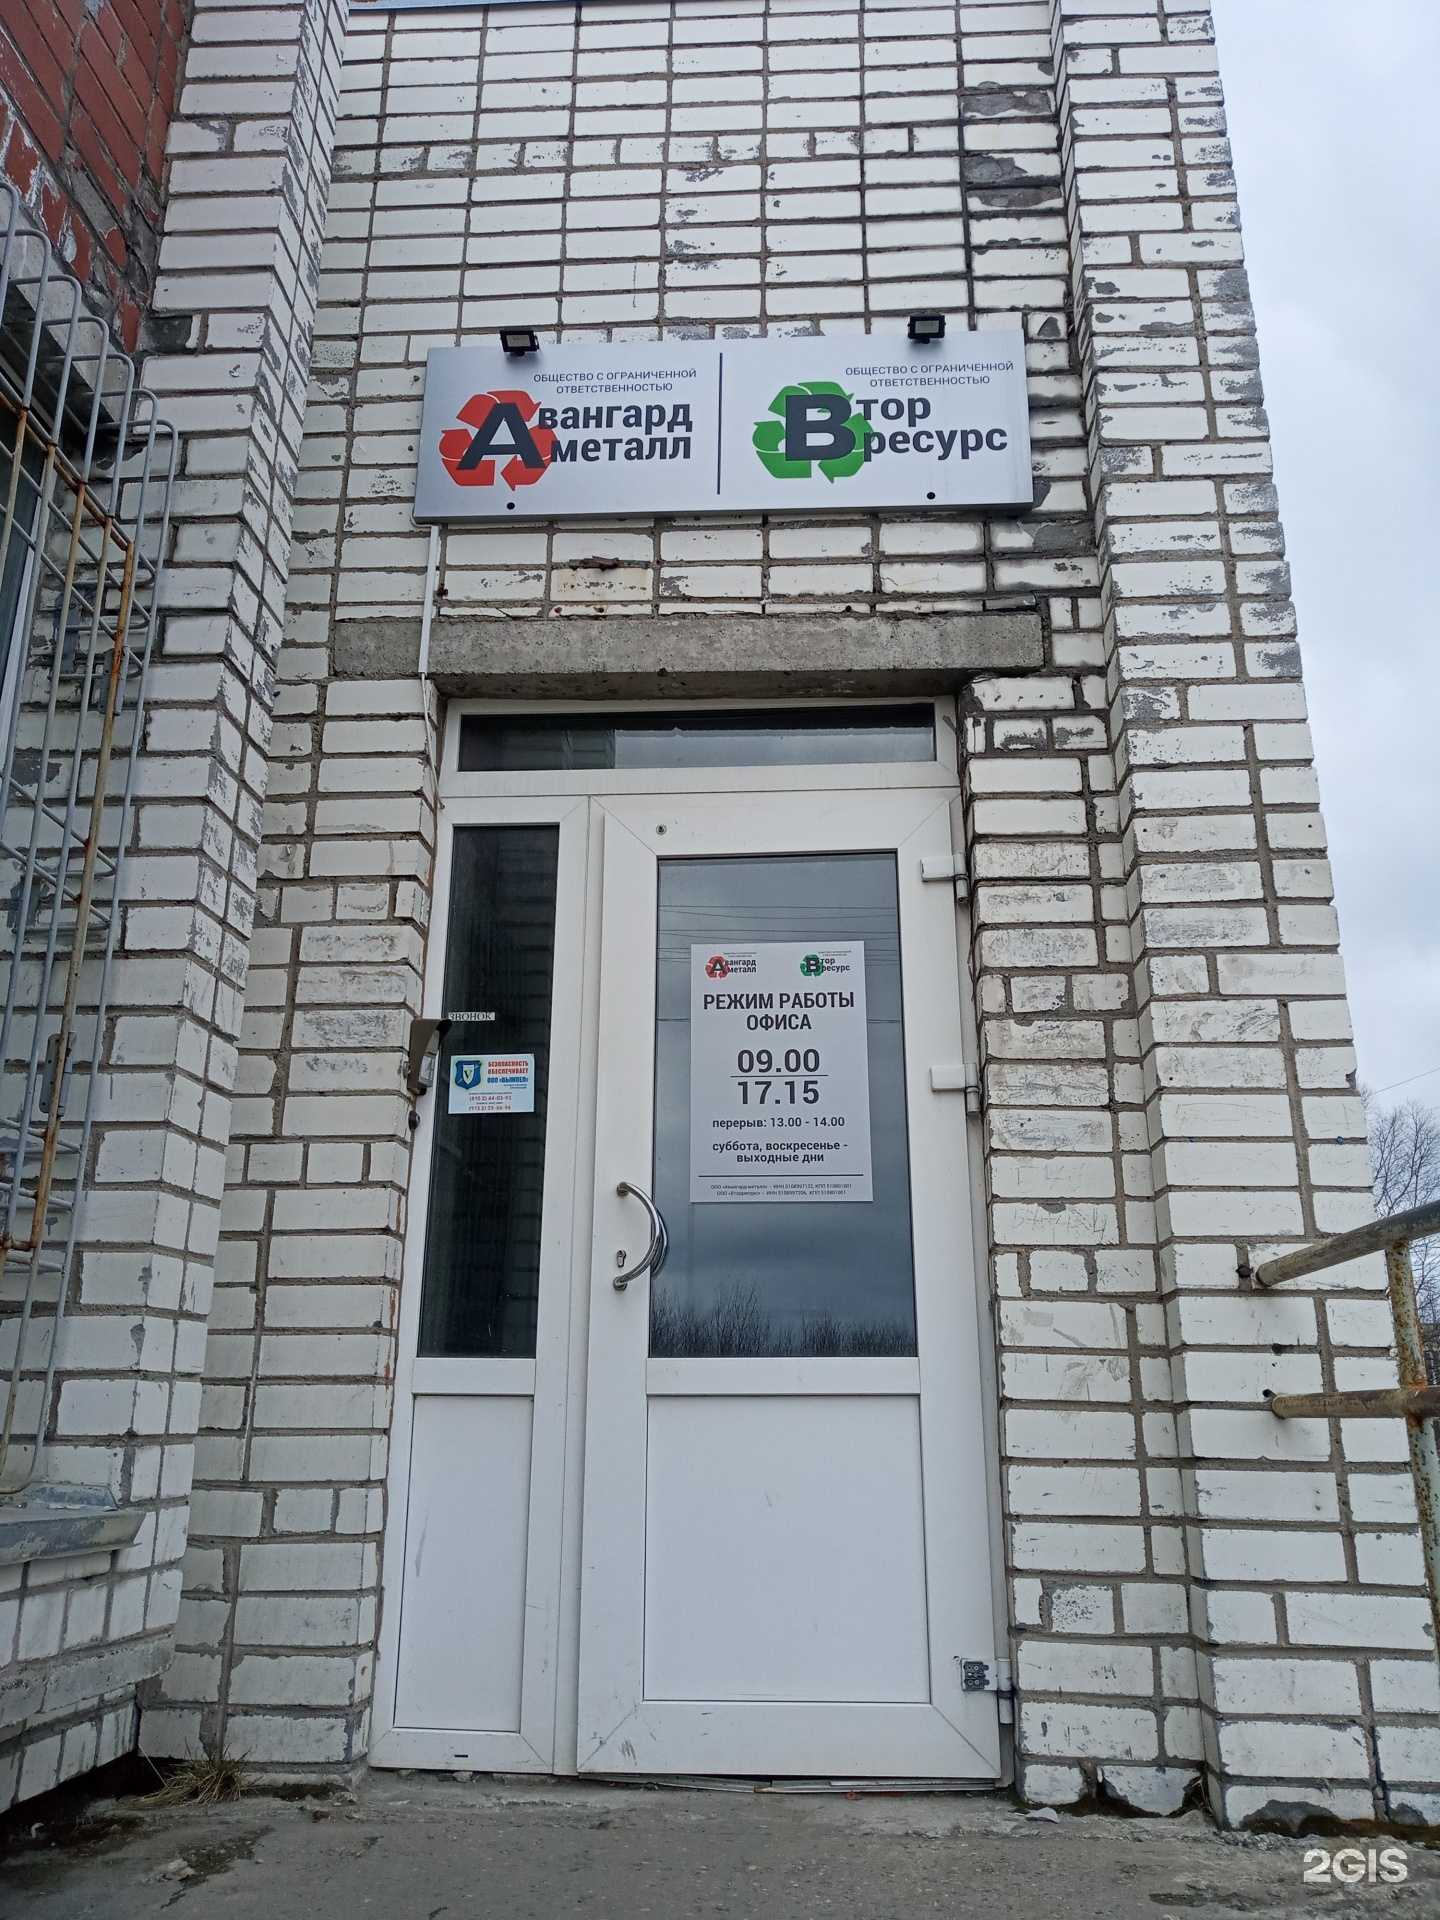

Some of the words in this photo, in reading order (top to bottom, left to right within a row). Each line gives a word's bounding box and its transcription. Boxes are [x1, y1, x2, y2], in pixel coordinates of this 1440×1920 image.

[533, 372, 594, 383] ОБЩЕСТВО
[596, 372, 604, 381] С
[606, 368, 697, 381] ОГРАНИЧЕННОЙ
[845, 366, 908, 376] ОБЩЕСТВО
[910, 365, 918, 374] С
[920, 361, 1014, 373] ОГРАНИЧЕННОЙ
[556, 382, 673, 394] ОТВЕТСТВЕННОСТЬЮ
[869, 375, 990, 388] ОТВЕТСТВЕННОСТЬЮ
[551, 436, 692, 462] металл
[863, 427, 1008, 462] ресурс
[703, 993, 774, 1010] РЕЖИМ
[779, 992, 855, 1009] РАБОТЫ
[746, 1014, 812, 1031] ОФИСА
[737, 1049, 820, 1073] 09.00
[737, 1080, 820, 1105] 17.15
[712, 1118, 767, 1130] перерыв:
[770, 1117, 802, 1128] 13.00
[813, 1117, 845, 1127] 14.00
[712, 1141, 762, 1154] суббота,
[765, 1141, 840, 1153] воскресенье
[736, 1153, 799, 1163] выходные
[801, 1153, 824, 1164] дни
